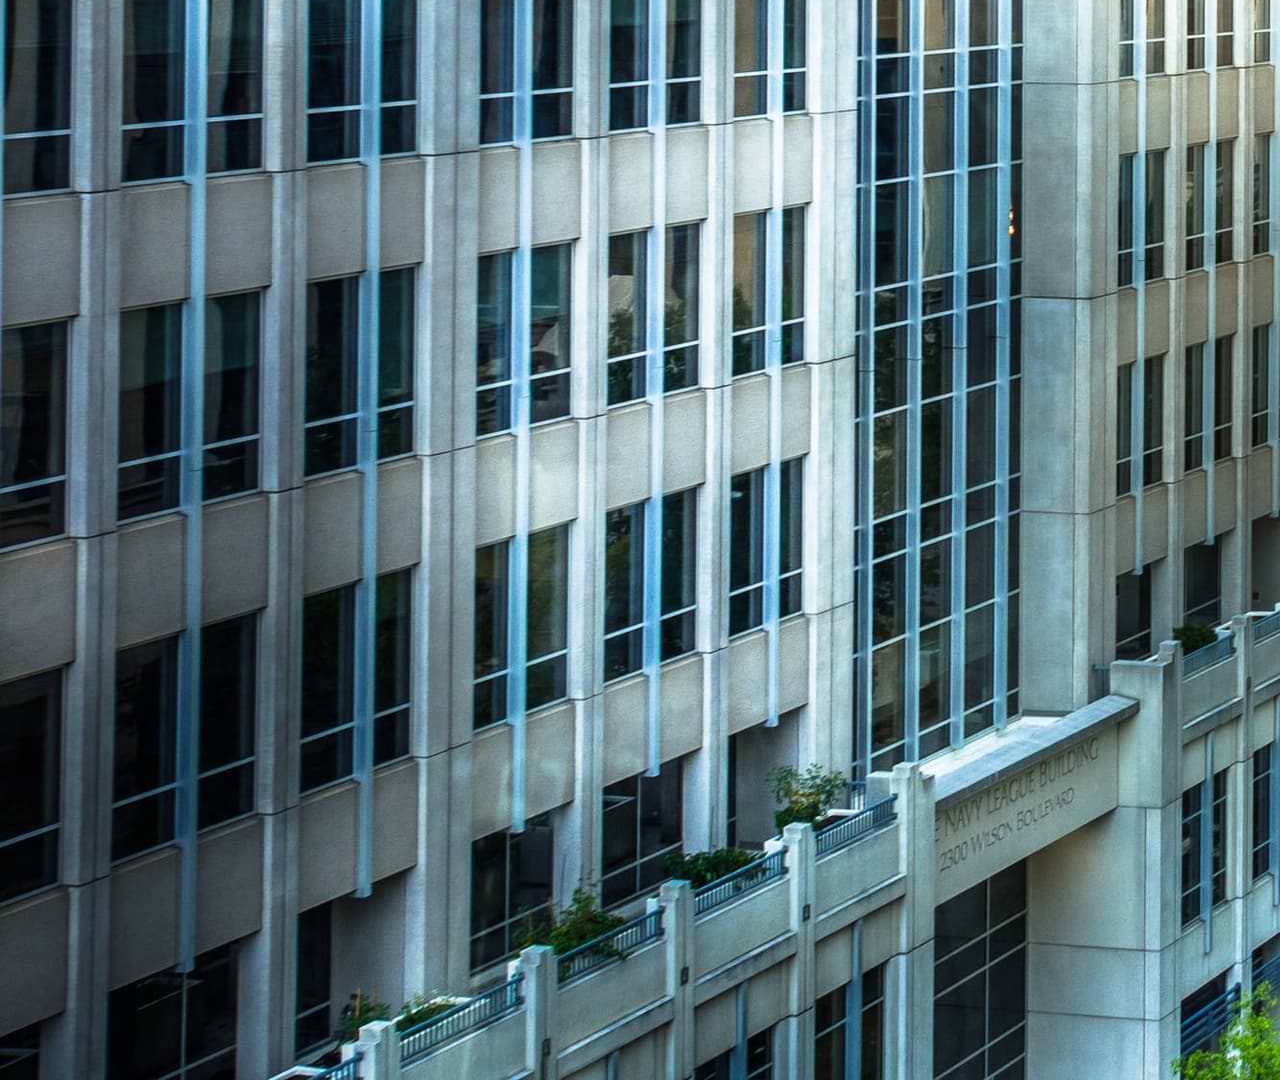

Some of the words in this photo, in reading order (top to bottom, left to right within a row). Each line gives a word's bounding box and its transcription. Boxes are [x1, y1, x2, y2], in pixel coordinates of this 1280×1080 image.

[940, 841, 969, 872] 2300
[970, 820, 1013, 853] WILSON
[1016, 787, 1075, 831] BOULEVARD
[944, 795, 984, 837] NAVY
[986, 769, 1035, 815] LEAGUE
[1039, 736, 1099, 788] BUILDING
